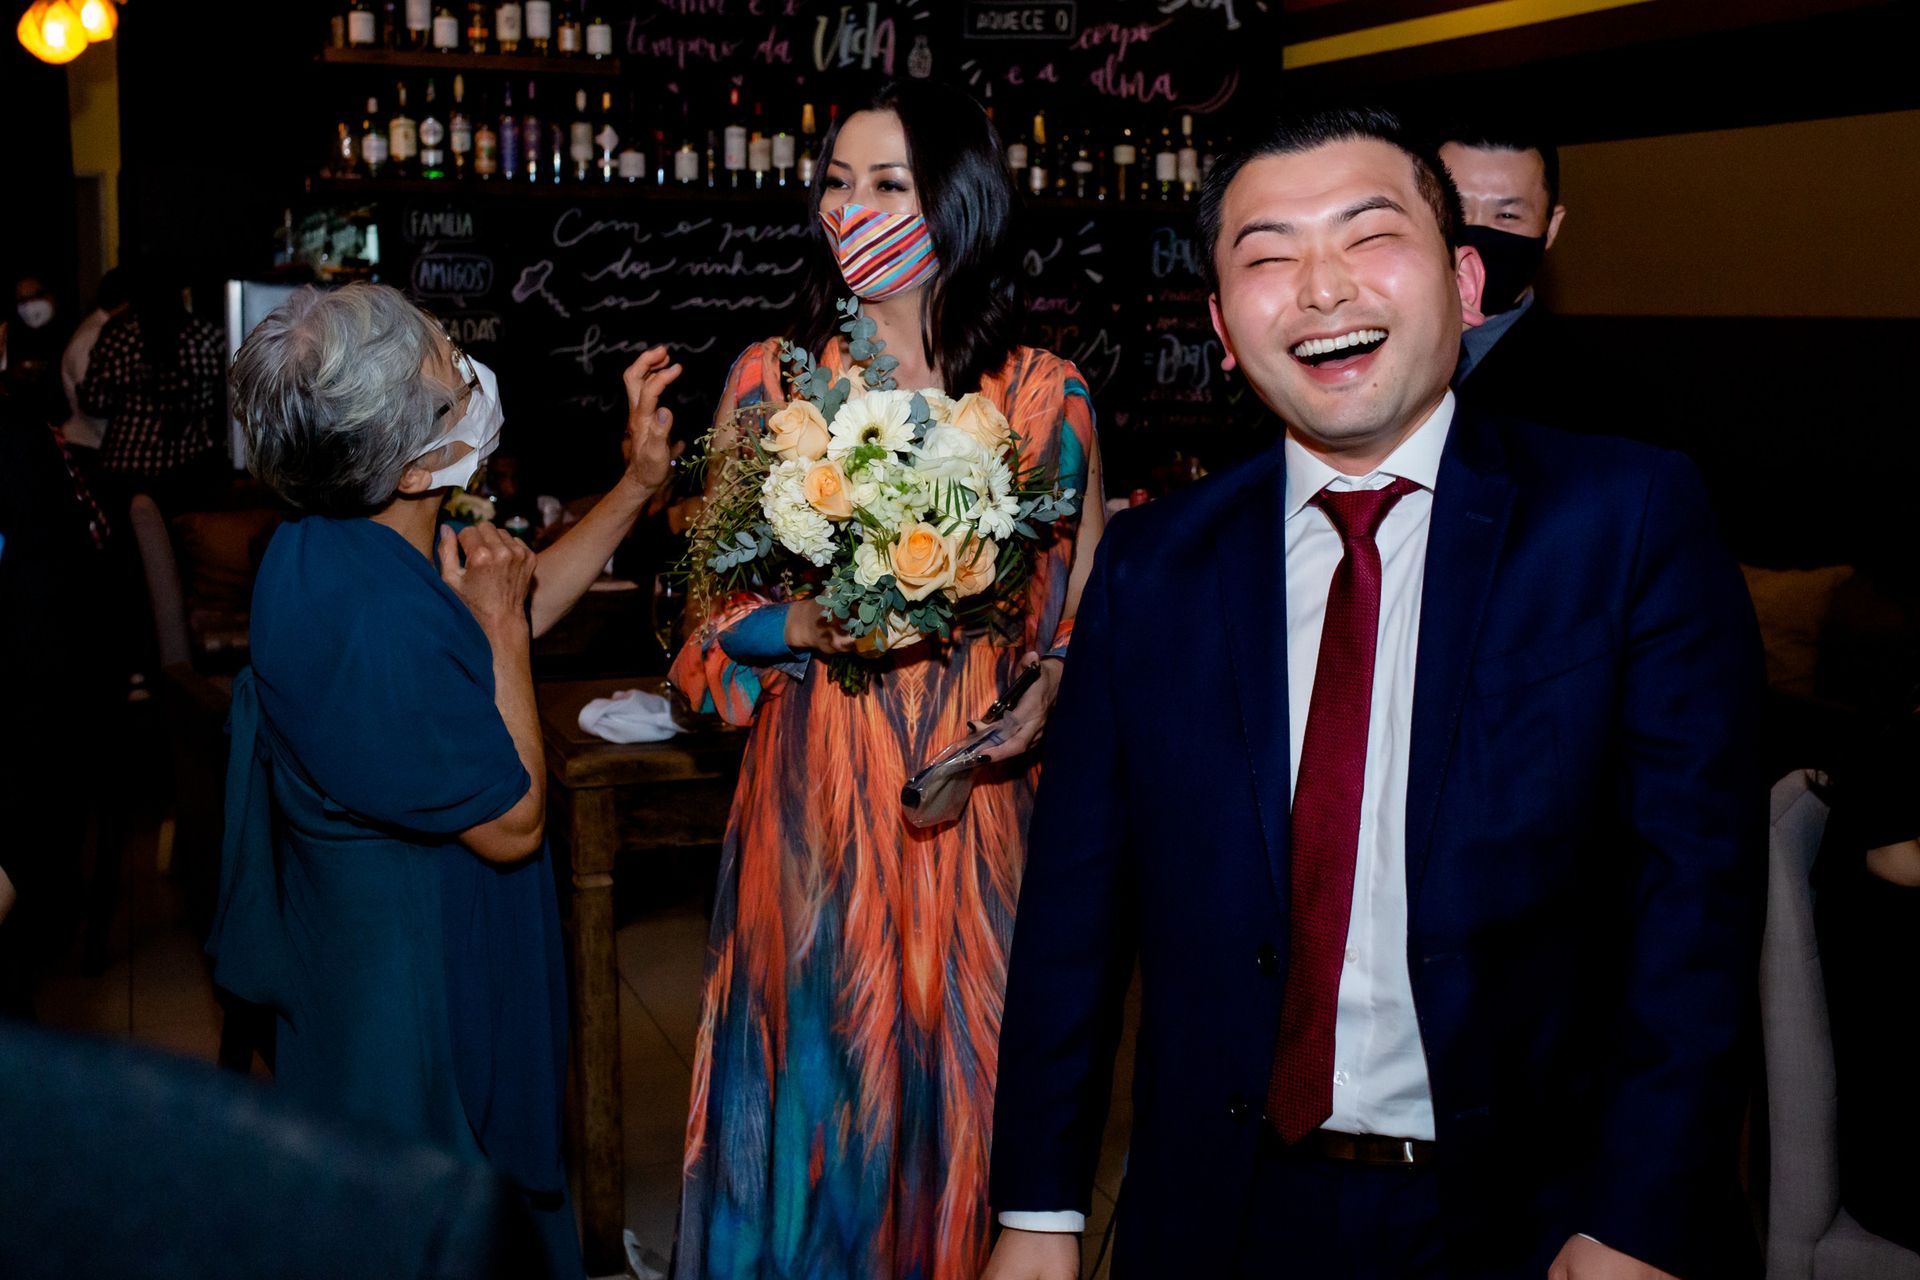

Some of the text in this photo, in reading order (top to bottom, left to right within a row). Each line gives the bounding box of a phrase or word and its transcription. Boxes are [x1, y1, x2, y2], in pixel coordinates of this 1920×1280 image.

[975, 9, 1069, 32] AQUECE O
[1068, 17, 1174, 62] corpo
[751, 23, 793, 66] da
[1087, 52, 1179, 103] alma
[552, 207, 652, 247] Com
[580, 247, 805, 282] dos vinhos
